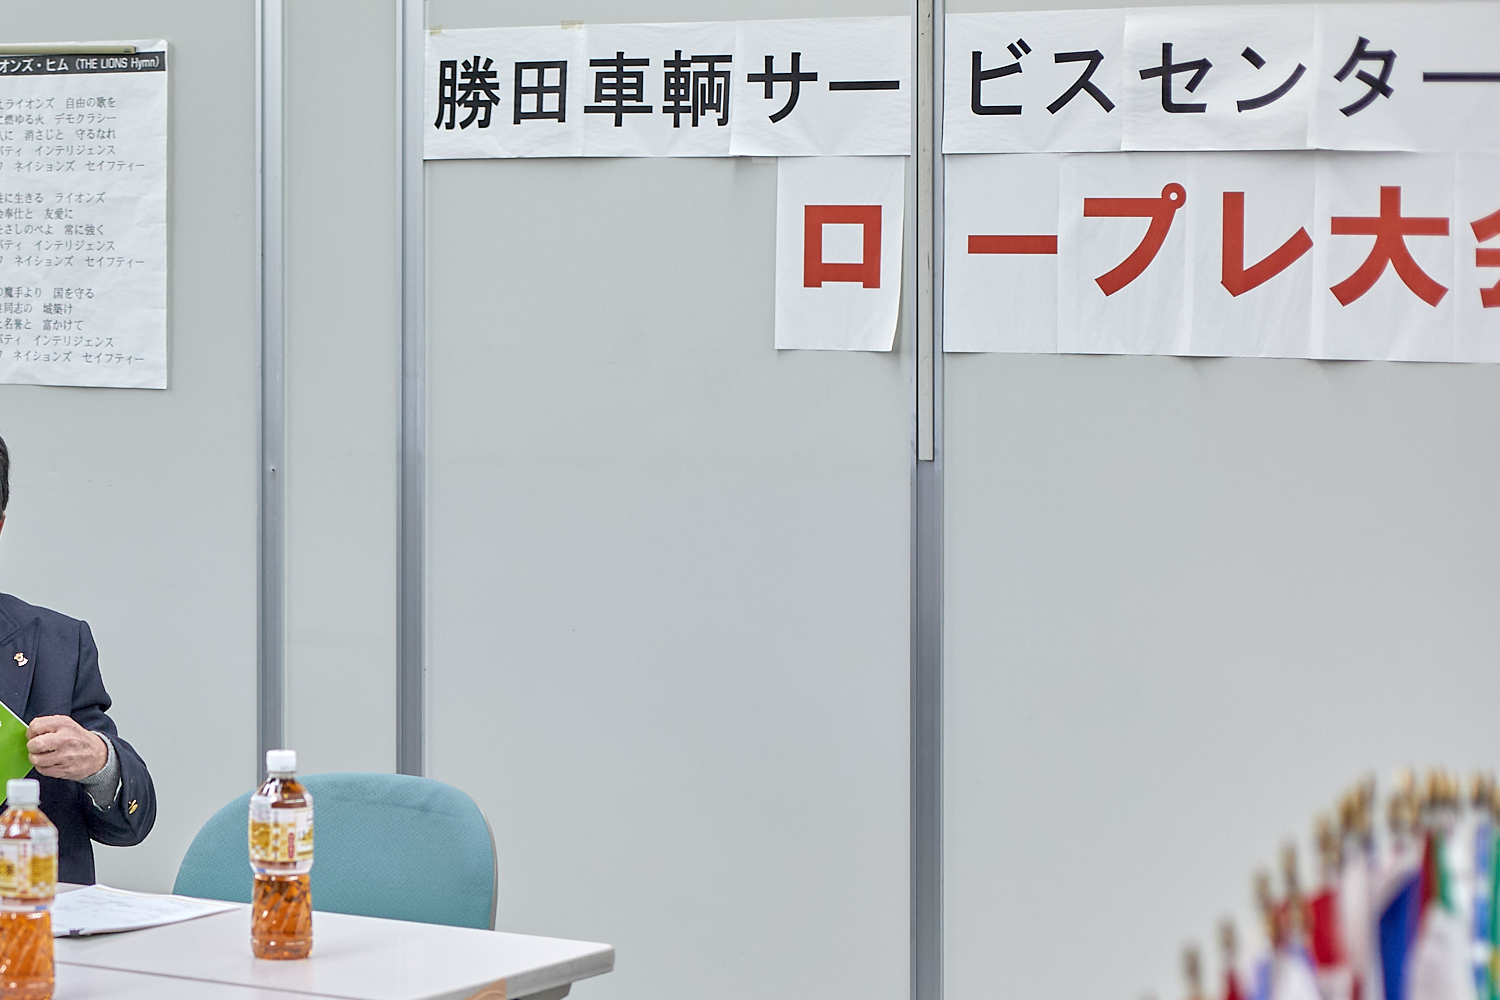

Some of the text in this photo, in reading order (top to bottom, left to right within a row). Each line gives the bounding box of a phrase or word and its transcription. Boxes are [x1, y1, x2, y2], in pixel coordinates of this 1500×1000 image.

[101, 57, 128, 69] LIONS
[66, 97, 116, 109] 自由の歌を
[55, 113, 116, 125] デモクラシー
[75, 128, 116, 140] 守るなれ
[35, 145, 115, 156] インテリジェンス
[14, 160, 75, 172] ネイションズ
[86, 161, 145, 171] セイフティー
[55, 192, 105, 203] ライオンズ
[44, 208, 73, 220] 友愛に
[64, 224, 103, 235] 常に強く
[34, 240, 114, 251] インテリジェンス
[804, 184, 1500, 307] ロープレ大
[15, 255, 74, 266] ネイションズ
[84, 256, 144, 267] セイフティー
[53, 288, 94, 299] 国を守る
[33, 335, 113, 347] インテリジェンス
[13, 350, 72, 362] ネイションズ
[82, 353, 144, 364] セイフティー
